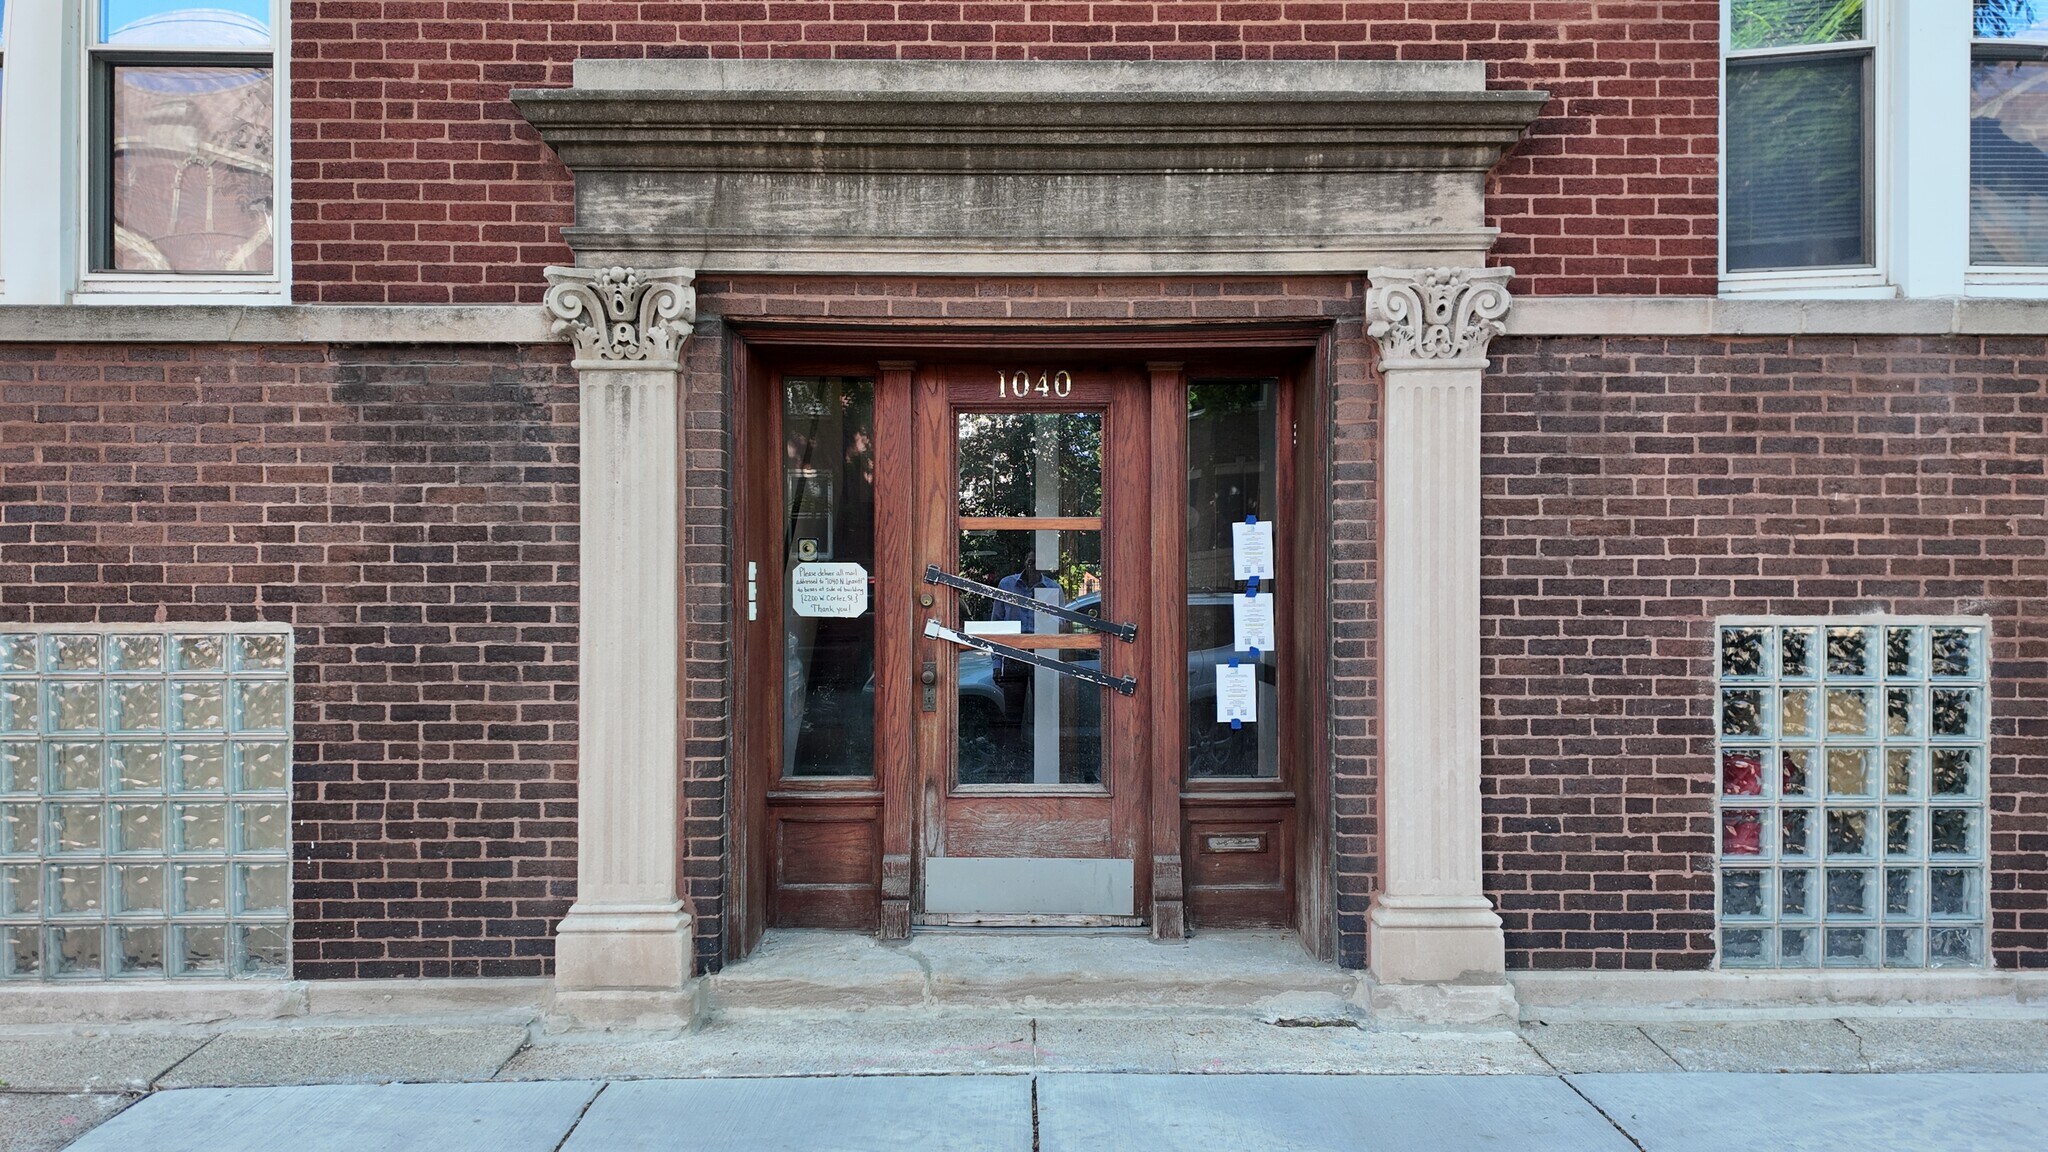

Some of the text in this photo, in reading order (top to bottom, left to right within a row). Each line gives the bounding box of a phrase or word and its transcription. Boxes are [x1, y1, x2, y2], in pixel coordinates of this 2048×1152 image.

[997, 369, 1071, 397] 1040
[800, 567, 816, 576] Please
[818, 568, 834, 576] deliver
[811, 604, 850, 614] Thank you!
